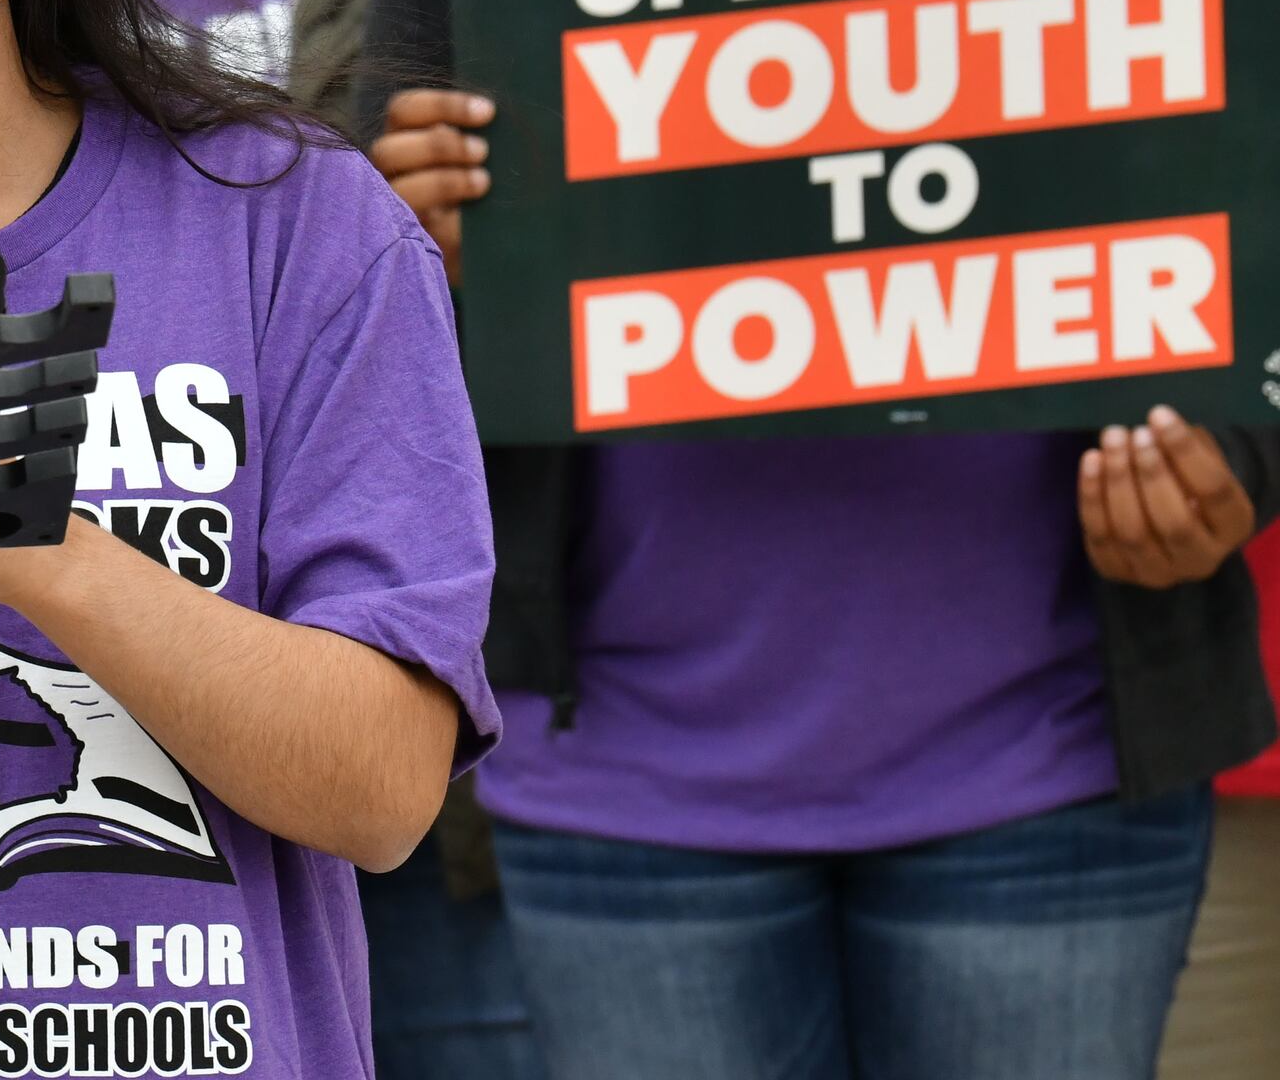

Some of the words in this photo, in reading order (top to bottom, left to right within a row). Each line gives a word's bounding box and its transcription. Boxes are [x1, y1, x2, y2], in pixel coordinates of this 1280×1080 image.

[808, 143, 979, 243] TO
[584, 234, 1217, 416] POWER
[136, 923, 247, 989] FOR
